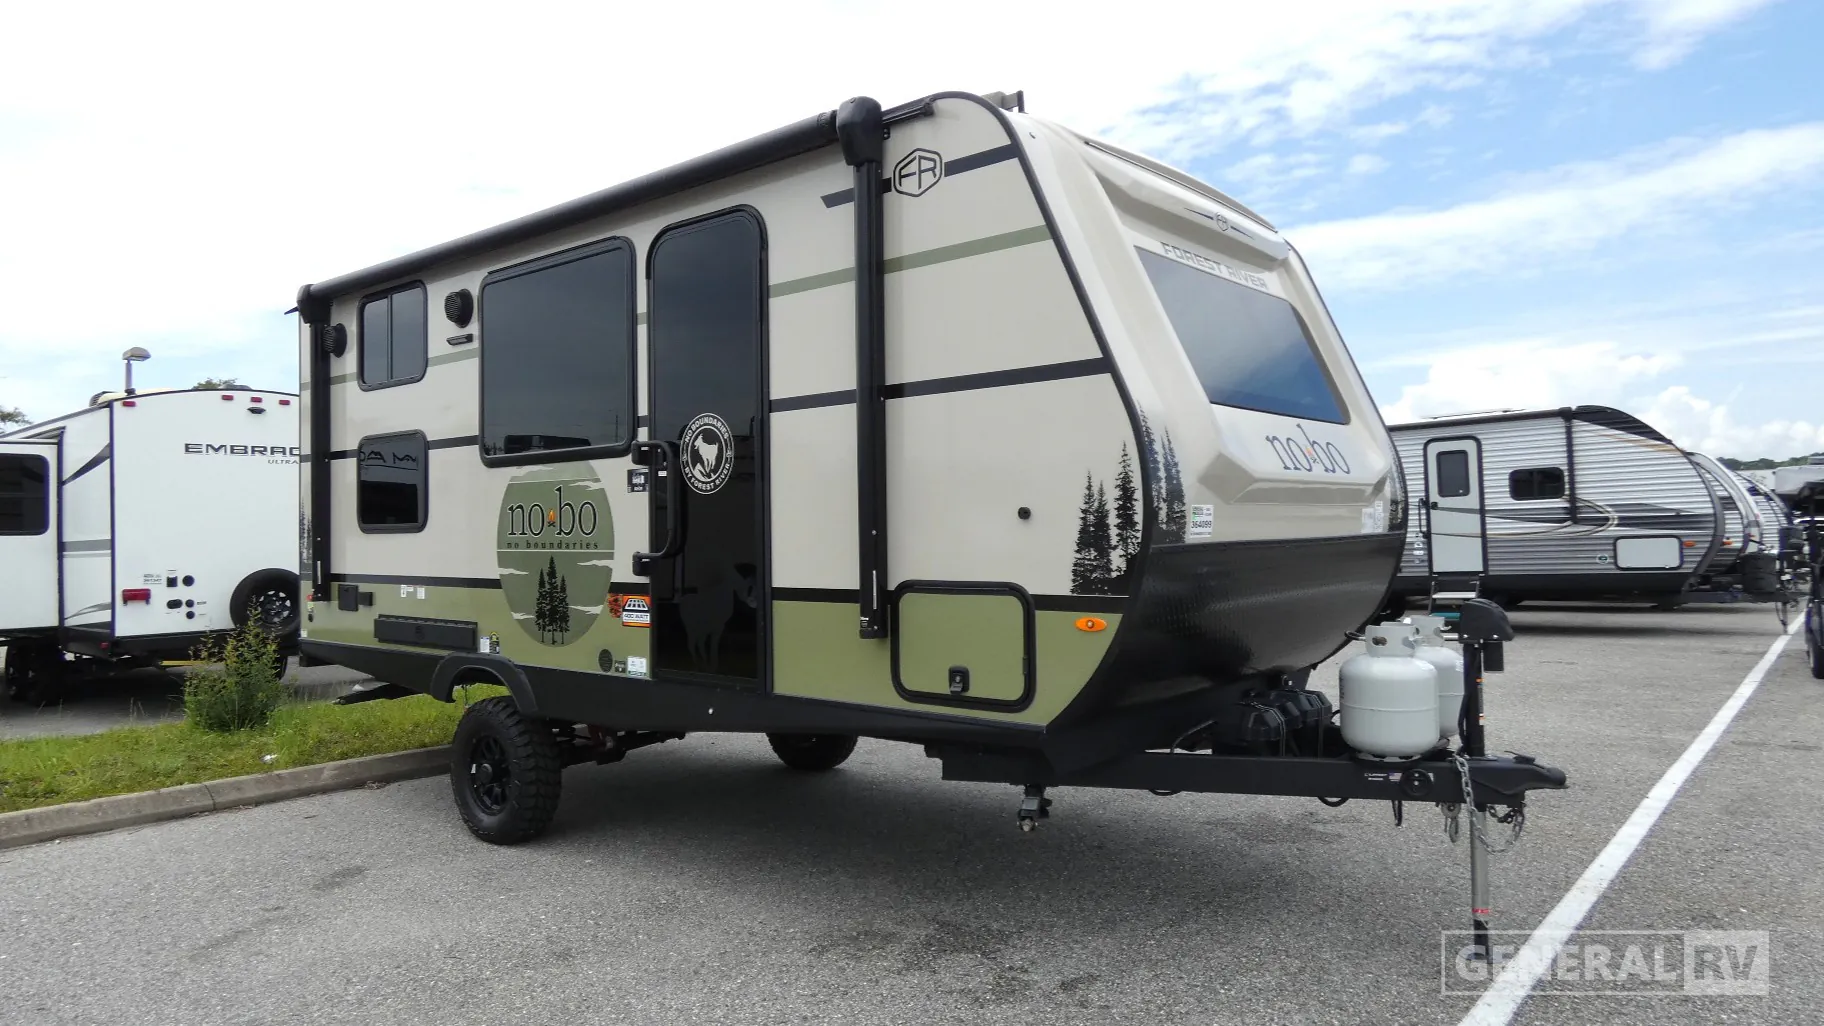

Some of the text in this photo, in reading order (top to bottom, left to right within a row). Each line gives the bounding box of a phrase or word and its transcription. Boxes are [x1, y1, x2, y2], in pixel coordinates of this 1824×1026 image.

[898, 154, 937, 190] FR
[1160, 241, 1269, 291] FOREST RIVER
[684, 415, 730, 443] NO BOUNDARIES
[684, 463, 730, 490] BY FOREST RIVER
[1191, 520, 1212, 529] 364099
[506, 540, 599, 550] no boundaries
